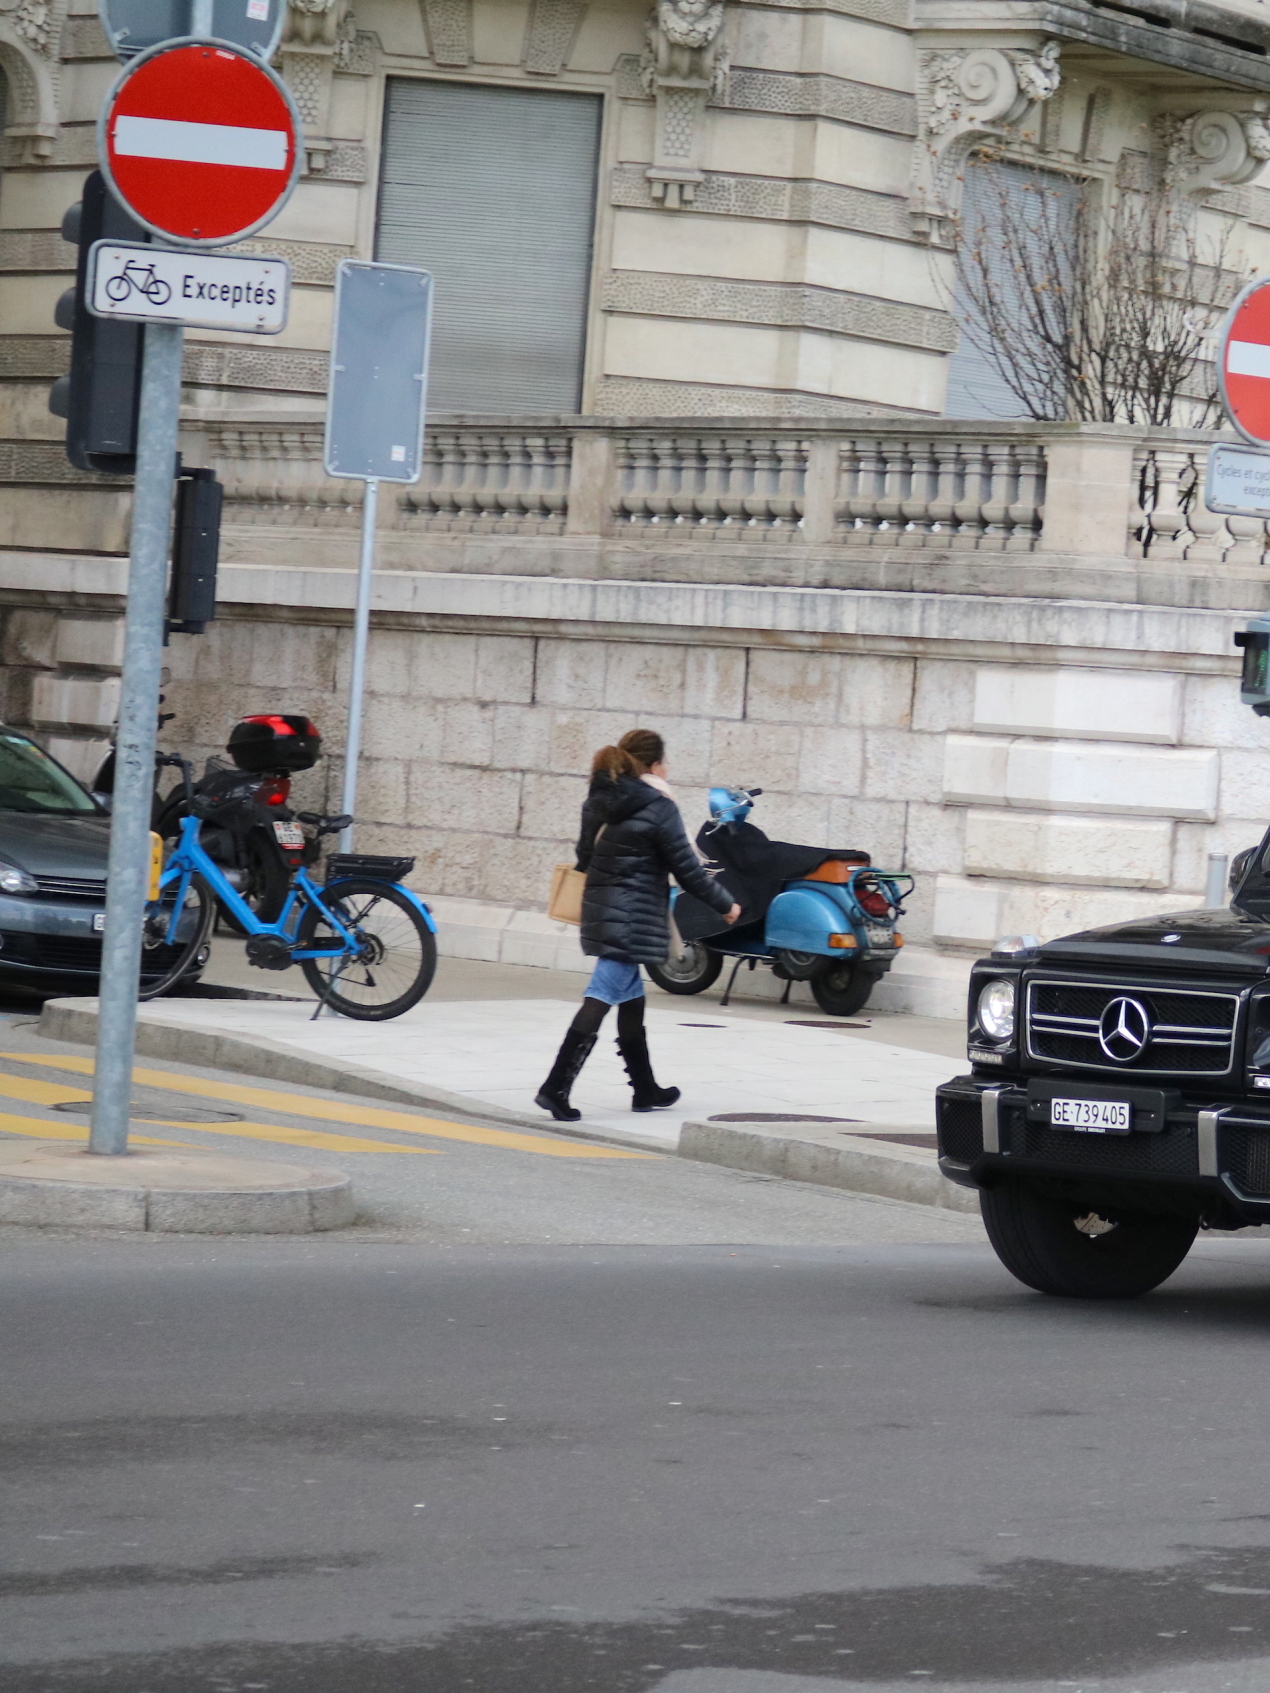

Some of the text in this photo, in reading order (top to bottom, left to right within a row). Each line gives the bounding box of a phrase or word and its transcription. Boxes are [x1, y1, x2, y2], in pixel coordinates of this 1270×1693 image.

[182, 274, 277, 309] Exceptés
[1216, 464, 1242, 479] Cycles
[1243, 468, 1253, 480] et
